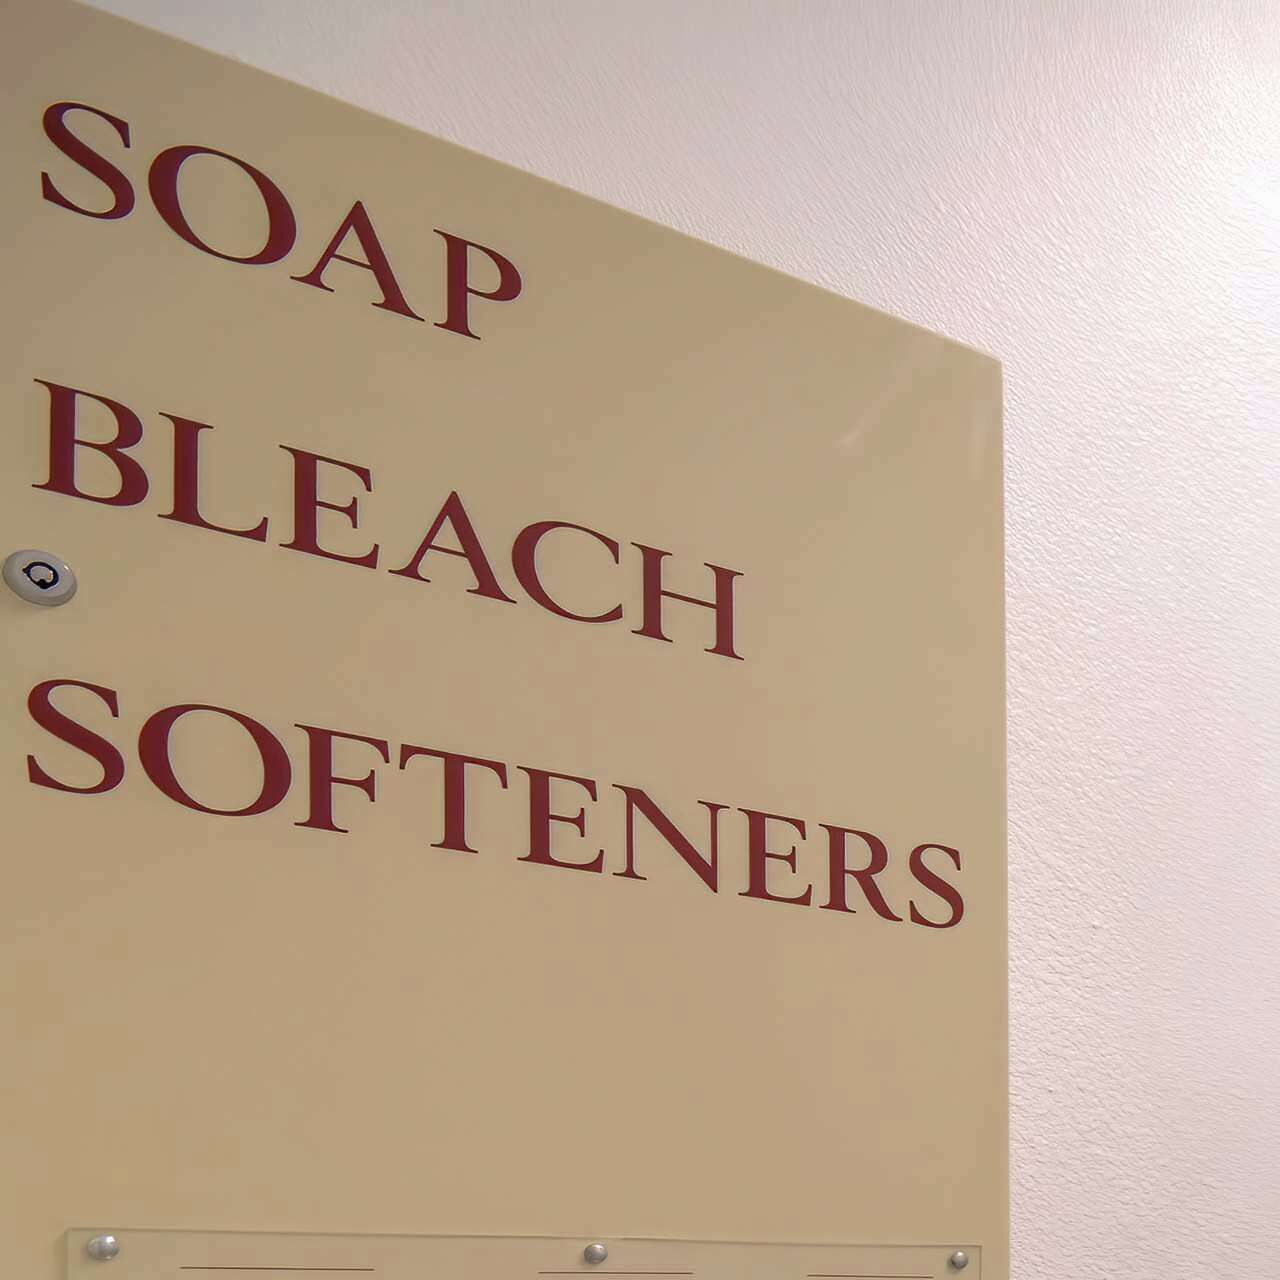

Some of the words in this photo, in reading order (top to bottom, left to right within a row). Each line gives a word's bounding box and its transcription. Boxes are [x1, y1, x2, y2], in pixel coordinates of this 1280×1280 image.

[40, 101, 523, 340] SOAP
[31, 378, 744, 661] BLEACH
[26, 678, 966, 929] SOFTENERS
